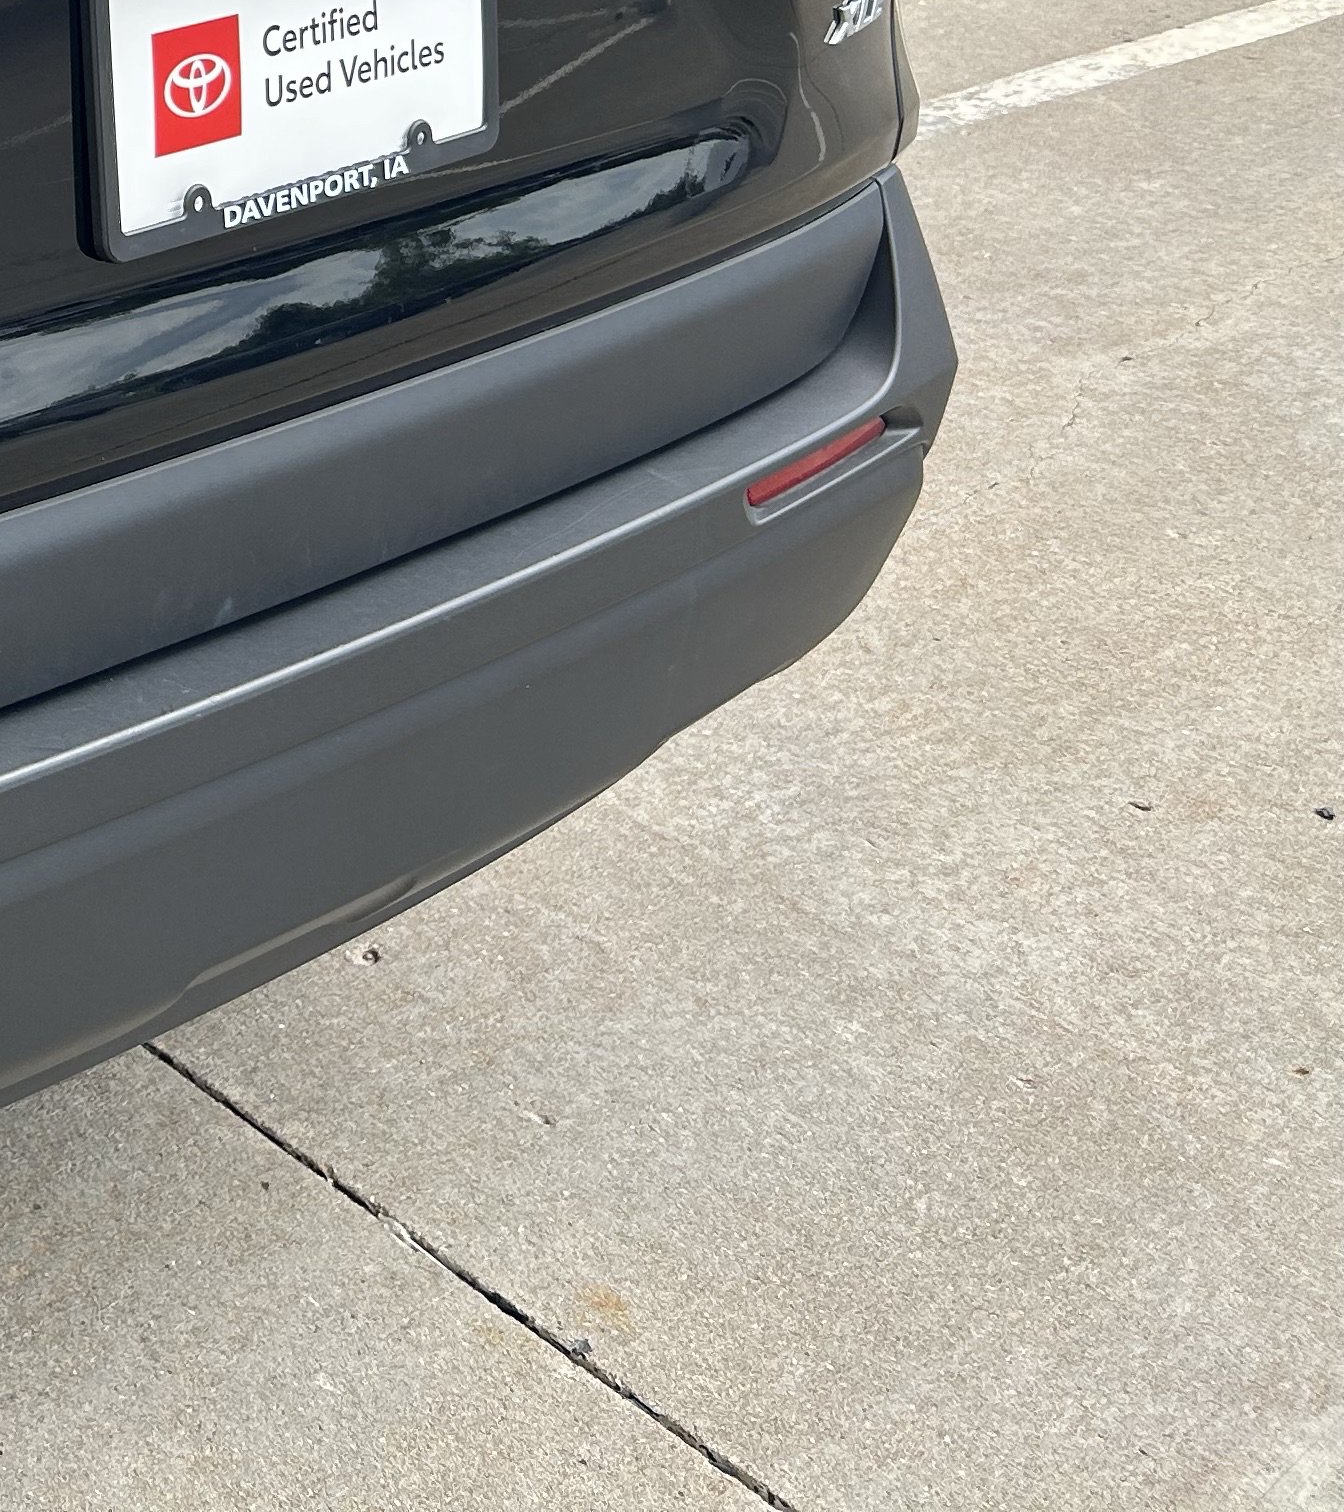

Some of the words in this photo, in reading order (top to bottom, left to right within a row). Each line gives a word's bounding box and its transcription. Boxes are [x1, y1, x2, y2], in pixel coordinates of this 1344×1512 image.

[264, 61, 332, 108] Used
[339, 38, 446, 86] Vehicles
[223, 164, 379, 229] DAVENPORT,
[383, 155, 410, 178] IA
